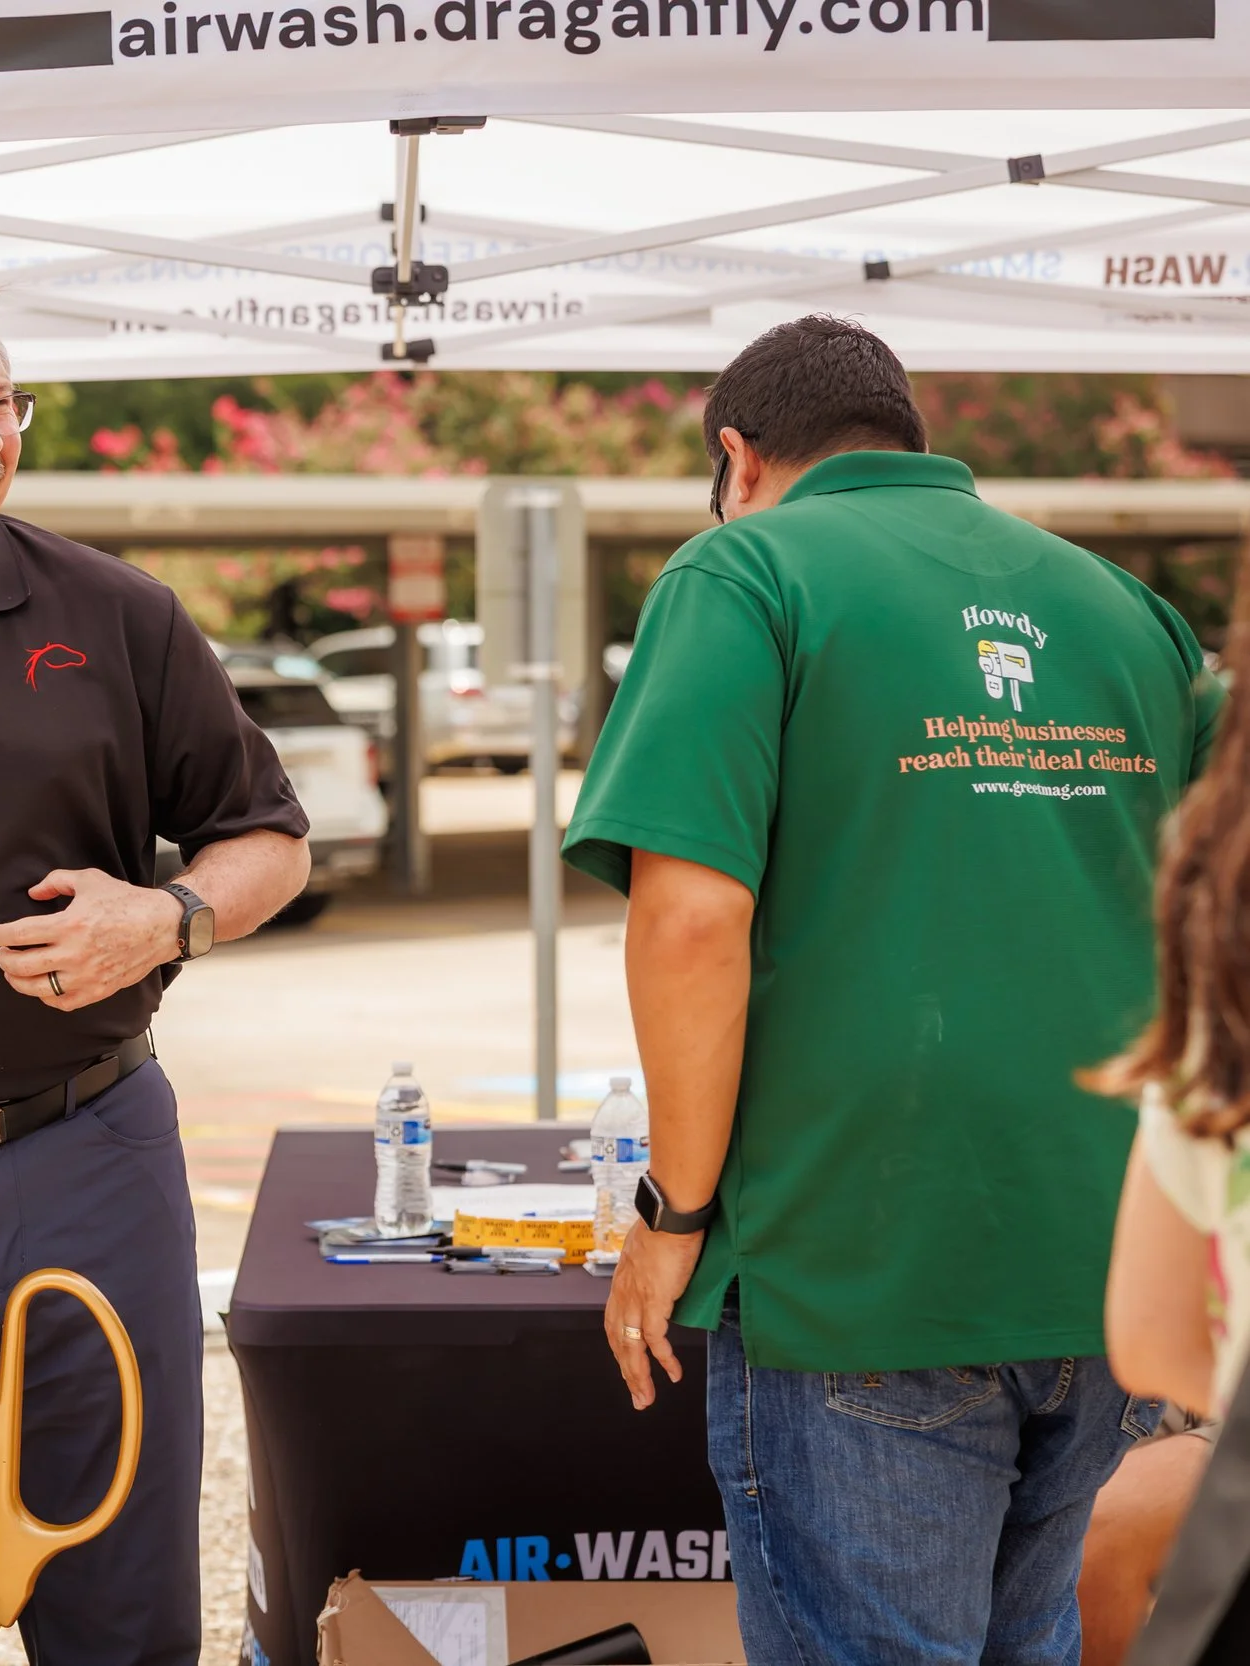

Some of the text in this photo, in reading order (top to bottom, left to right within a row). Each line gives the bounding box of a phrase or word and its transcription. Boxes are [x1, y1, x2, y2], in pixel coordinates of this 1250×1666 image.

[961, 604, 1048, 649] Howdy
[923, 715, 1126, 743] Helping businesses
[898, 745, 1157, 774] reach their ideal clients
[971, 780, 1106, 800] www.greetmag.com
